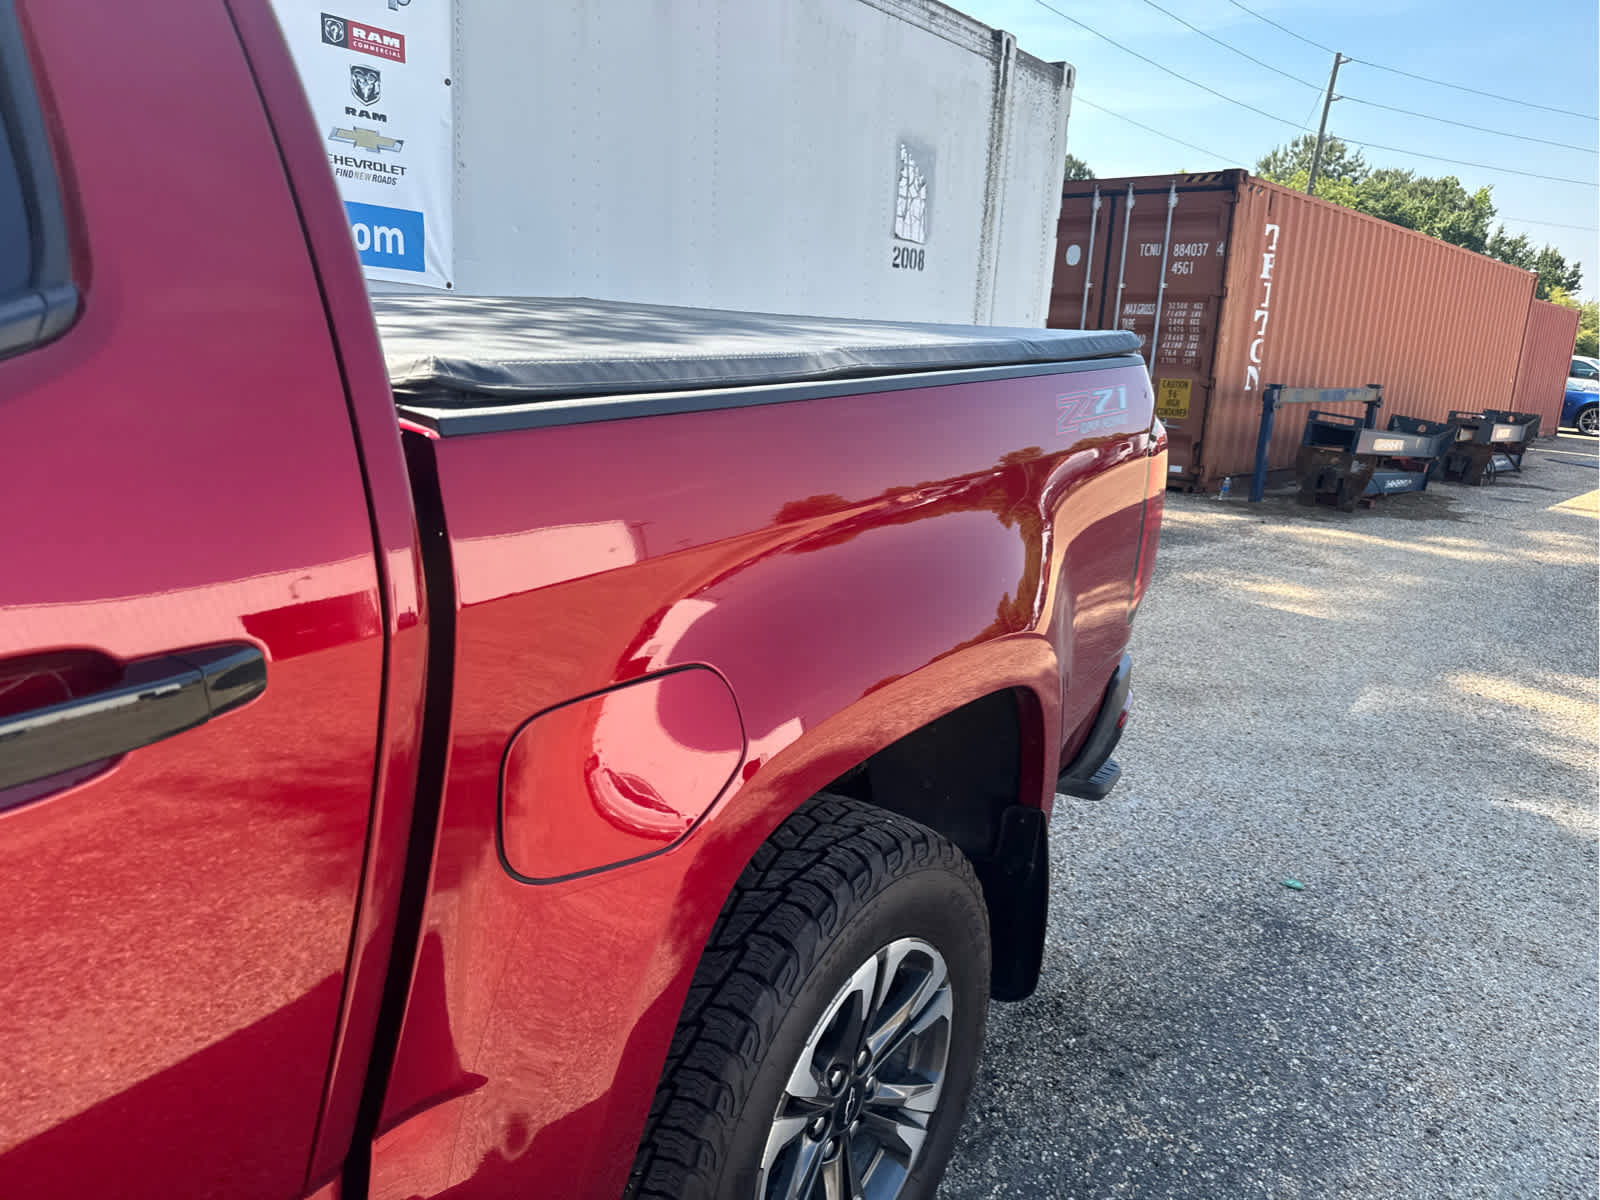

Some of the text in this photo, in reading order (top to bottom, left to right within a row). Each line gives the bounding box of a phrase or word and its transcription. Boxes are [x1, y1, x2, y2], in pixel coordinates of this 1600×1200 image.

[352, 27, 400, 48] RAM
[352, 40, 401, 58] COMMERCIAL
[344, 106, 387, 122] RAM
[335, 168, 354, 179] FIND
[372, 174, 398, 186] ROADS
[1140, 241, 1225, 256] TCNU 884037 4
[892, 246, 925, 271] 2008
[1171, 261, 1194, 274] 45G1
[1056, 385, 1128, 435] Z71
